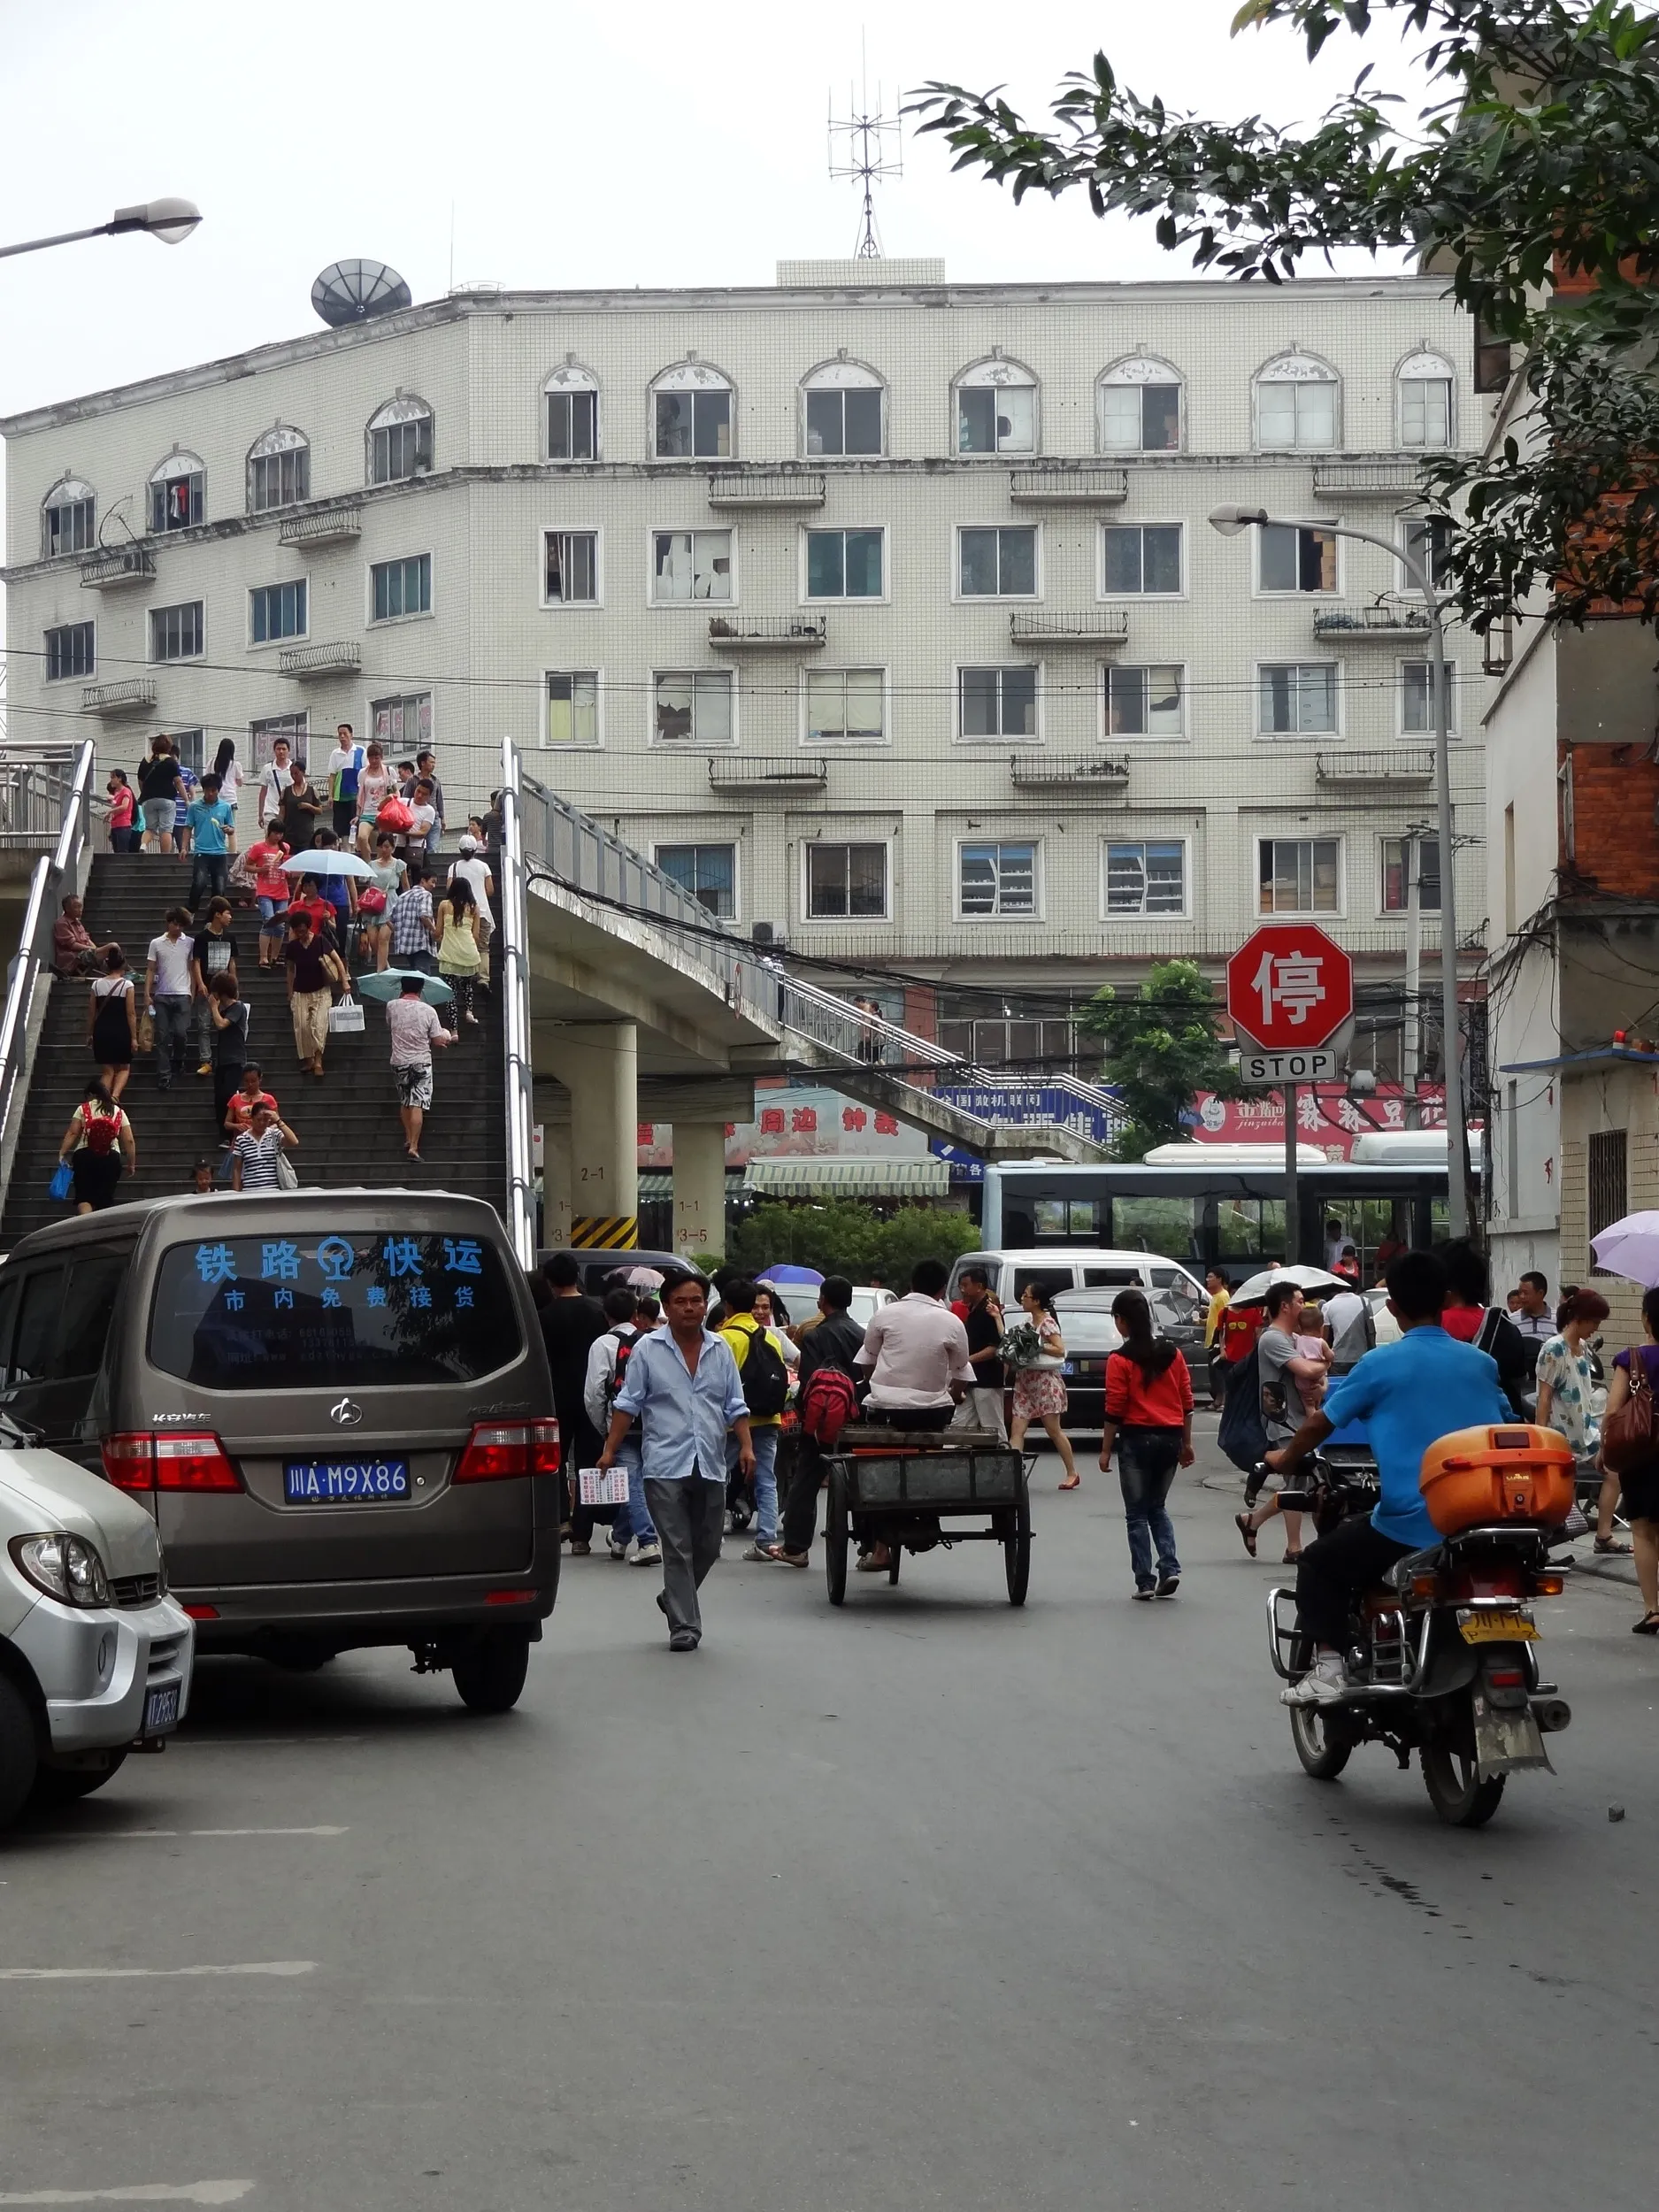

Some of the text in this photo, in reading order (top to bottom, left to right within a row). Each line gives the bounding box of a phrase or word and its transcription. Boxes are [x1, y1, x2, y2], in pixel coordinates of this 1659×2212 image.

[1250, 949, 1325, 1025] 停
[1250, 1056, 1327, 1078] STOP
[761, 1107, 817, 1134] 周边
[842, 1107, 899, 1137] 钟表
[580, 1166, 604, 1181] 2-1
[679, 1200, 700, 1211] 1-1
[195, 1237, 484, 1284] 铁路快运
[223, 1285, 476, 1312] 市内免费接货
[152, 1412, 211, 1423] 长安汽车
[289, 1465, 406, 1495] 川A·M9X86
